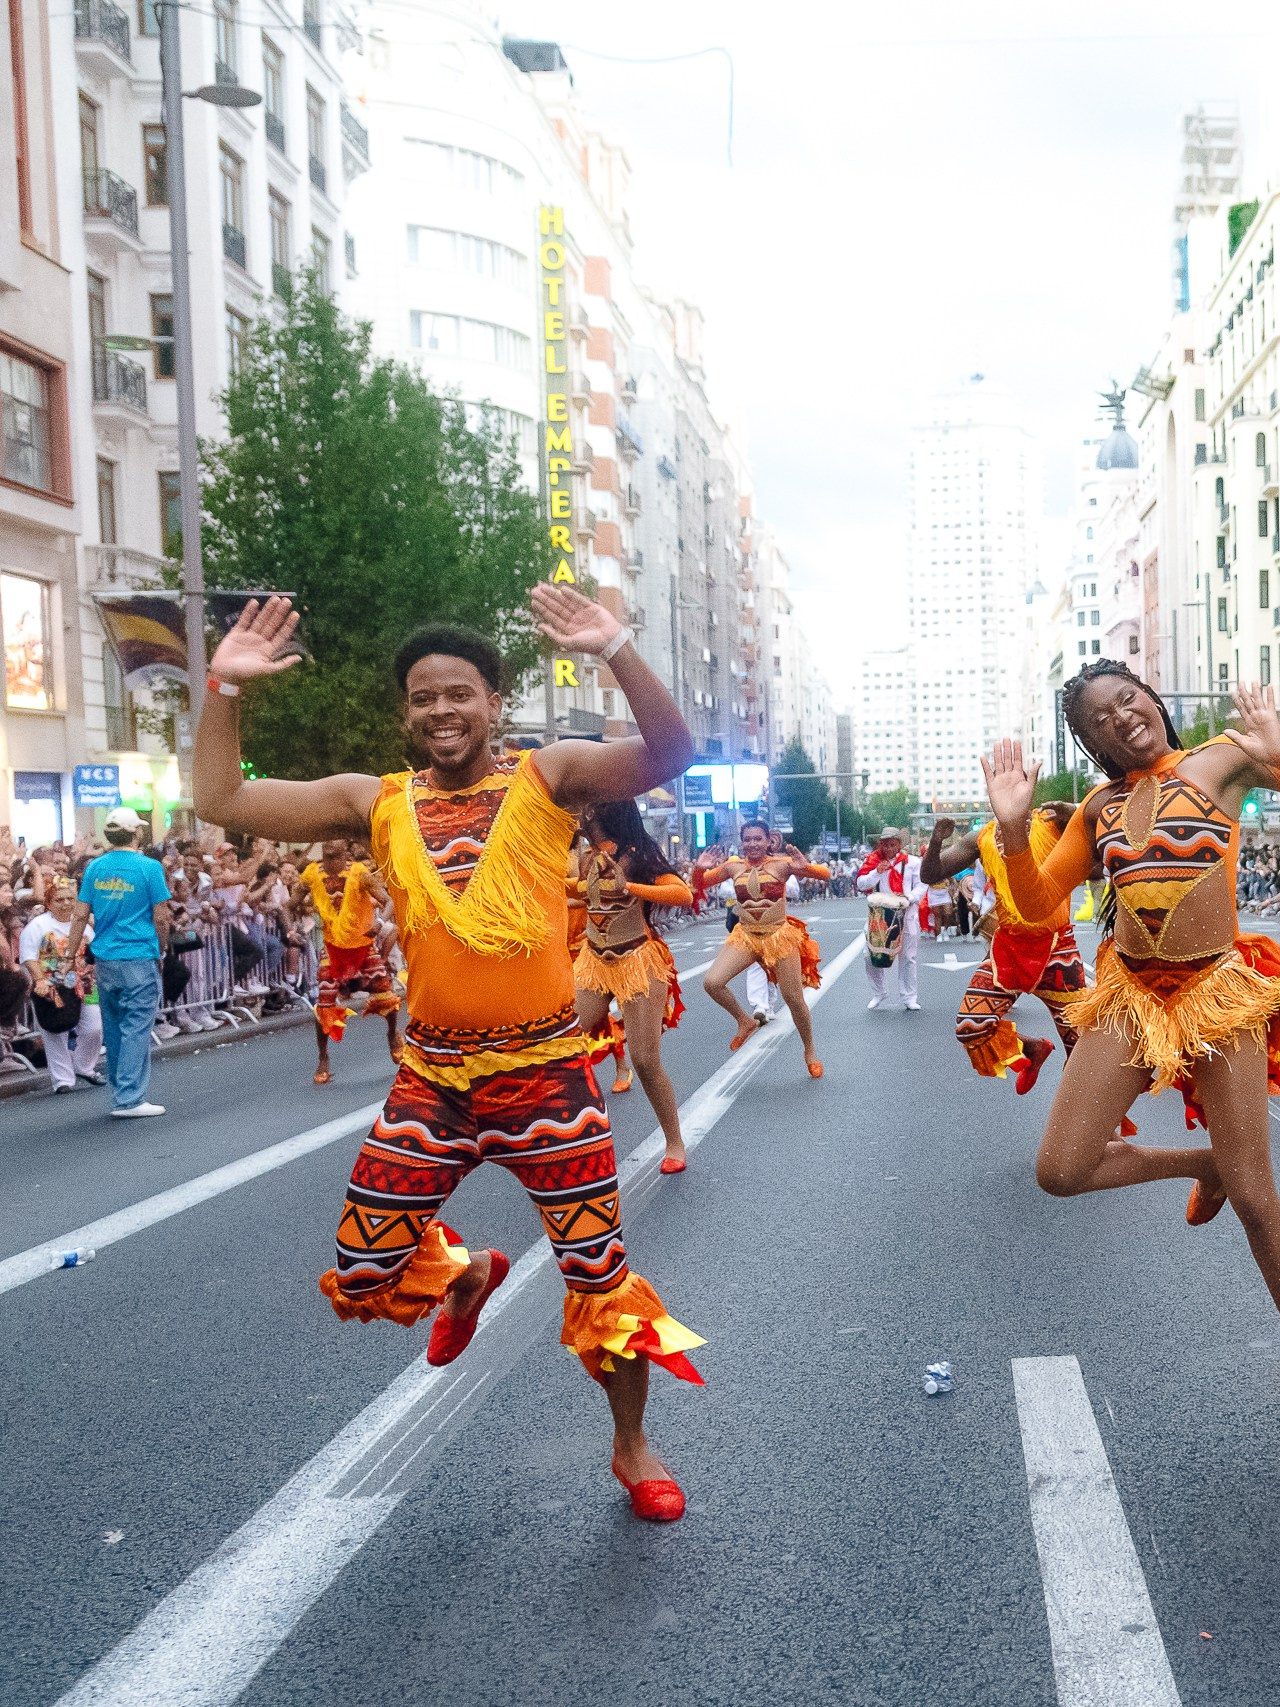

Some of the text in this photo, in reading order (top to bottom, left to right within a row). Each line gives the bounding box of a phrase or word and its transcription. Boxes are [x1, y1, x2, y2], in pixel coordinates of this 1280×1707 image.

[540, 207, 580, 687] HOTEL EMPERAR
[78, 784, 119, 795] Change
[80, 794, 117, 807] Money
